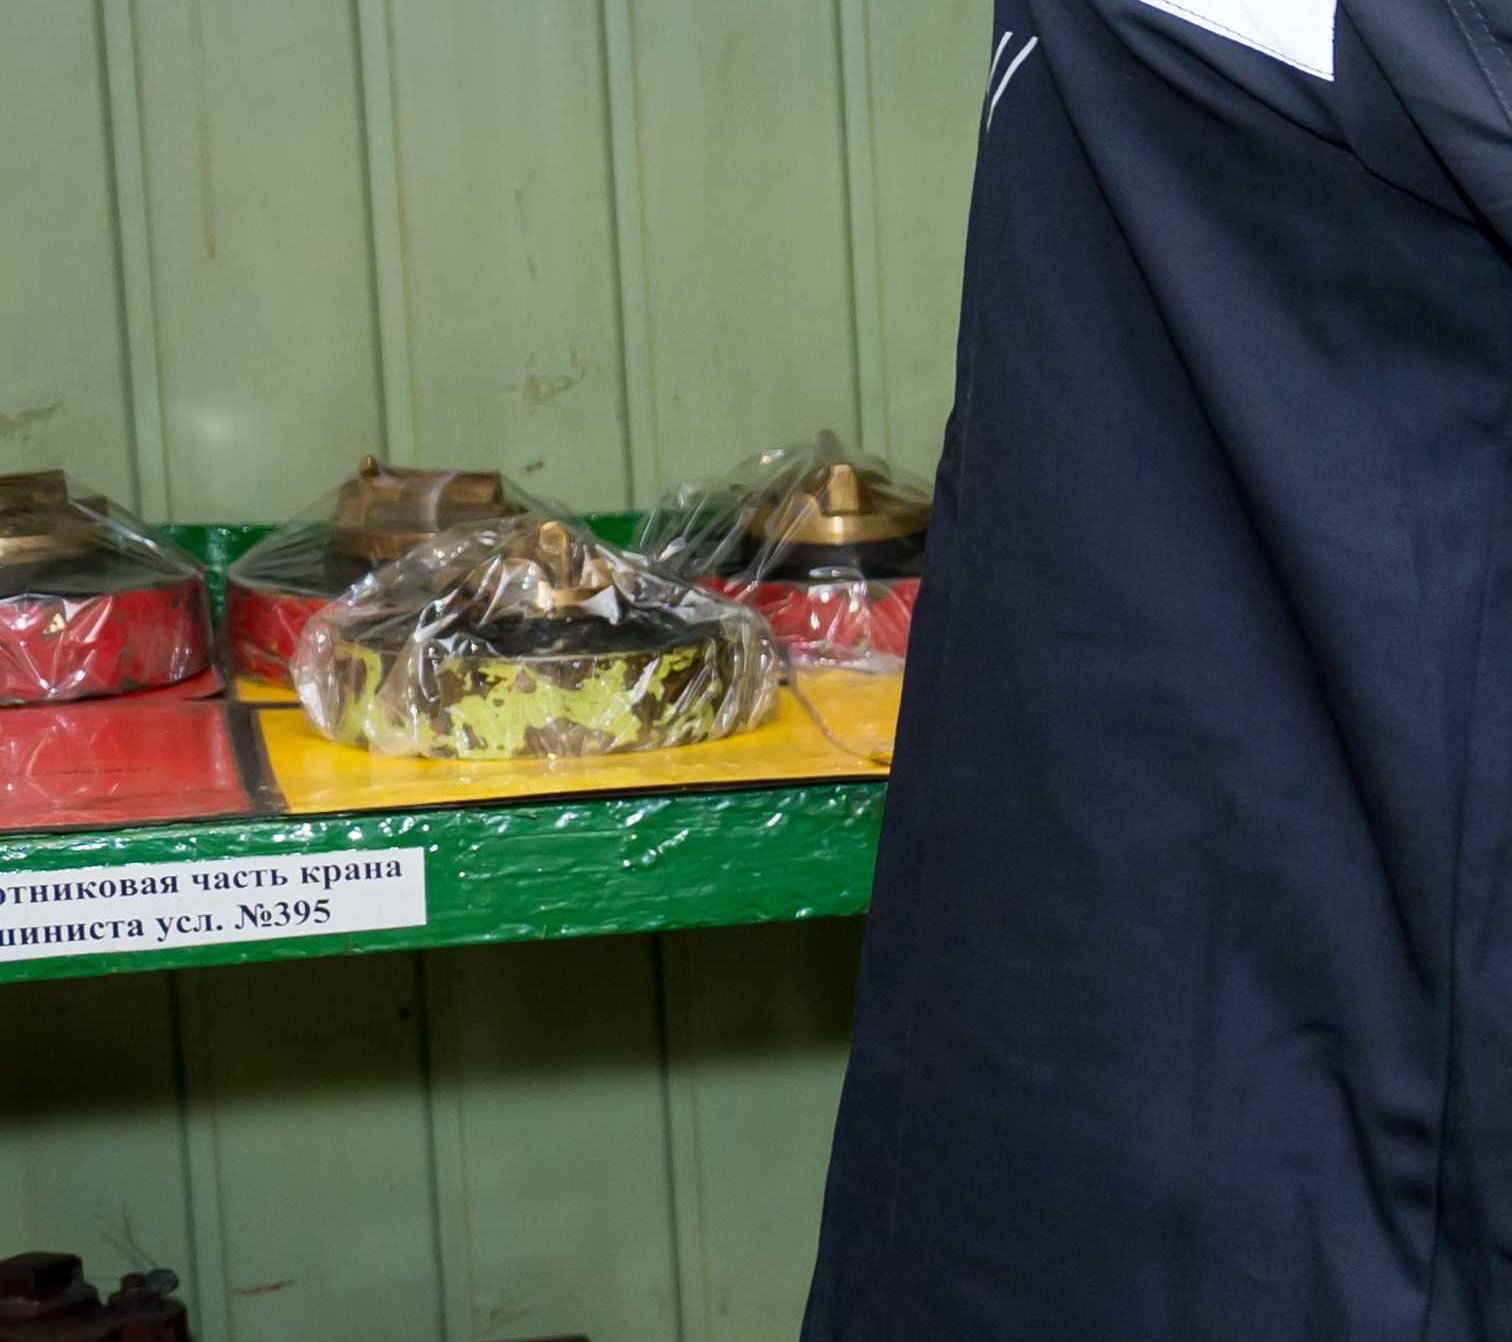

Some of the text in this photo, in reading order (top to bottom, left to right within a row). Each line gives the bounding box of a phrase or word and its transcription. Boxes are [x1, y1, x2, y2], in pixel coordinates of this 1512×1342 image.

[191, 867, 289, 893] часть
[300, 859, 403, 887] крана
[155, 913, 224, 943] усл.
[235, 898, 332, 931] №395
